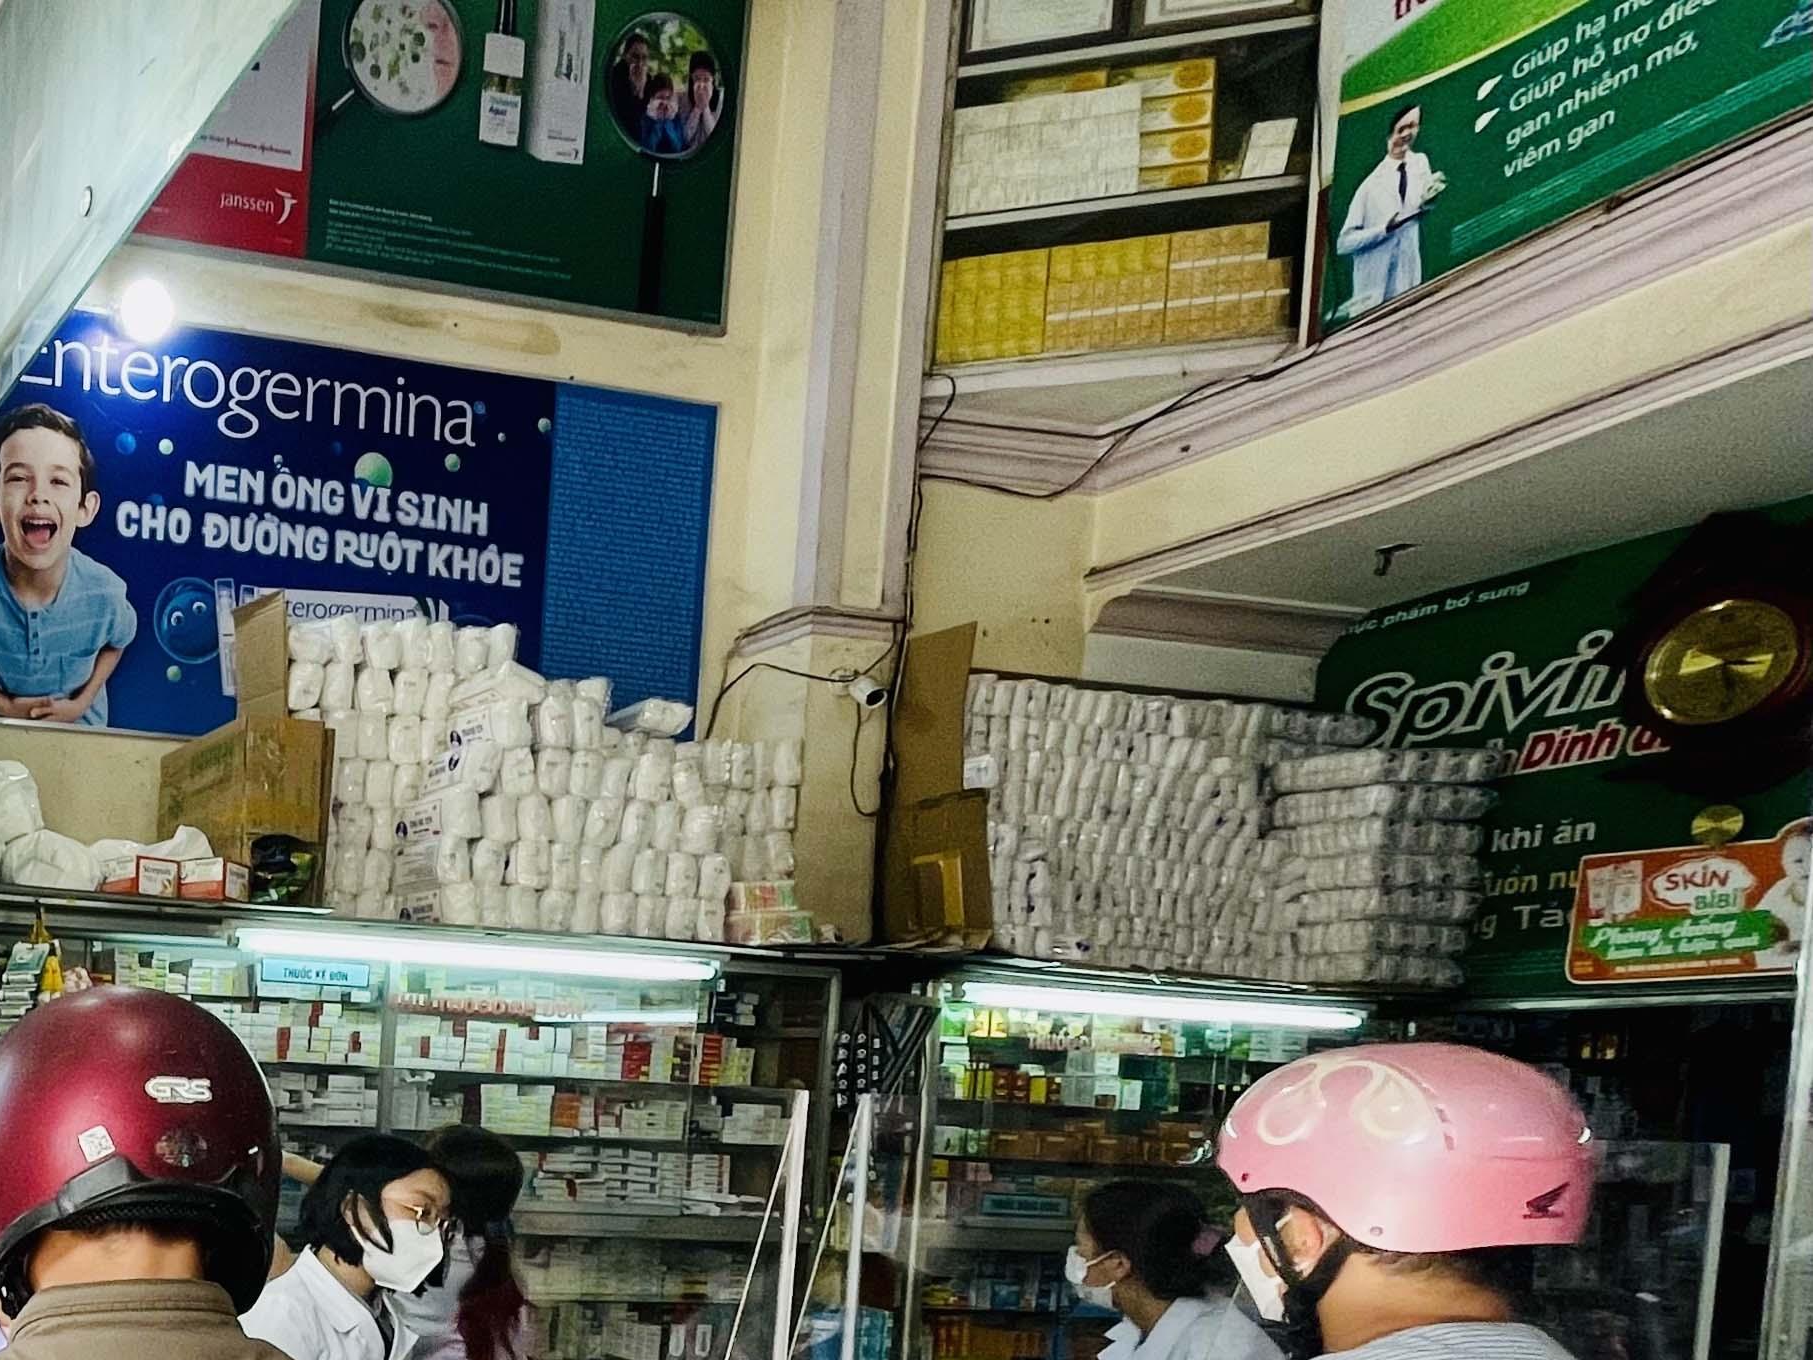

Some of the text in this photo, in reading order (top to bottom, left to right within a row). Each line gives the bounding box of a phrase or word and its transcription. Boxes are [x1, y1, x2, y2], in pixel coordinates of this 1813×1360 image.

[1509, 71, 1566, 112] Giúp
[1612, 17, 1654, 56] trợ
[1512, 36, 1569, 78] Giúp
[1575, 14, 1606, 44] hạ
[1503, 109, 1616, 178] viêm gan
[1506, 110, 1550, 151] gan
[219, 190, 275, 216] janssen
[183, 460, 265, 506] MEN
[352, 484, 392, 523] VI
[396, 491, 489, 536] SINH
[116, 501, 191, 544] CHO
[1477, 581, 1531, 602] sung
[1490, 818, 1597, 853] khi ăn
